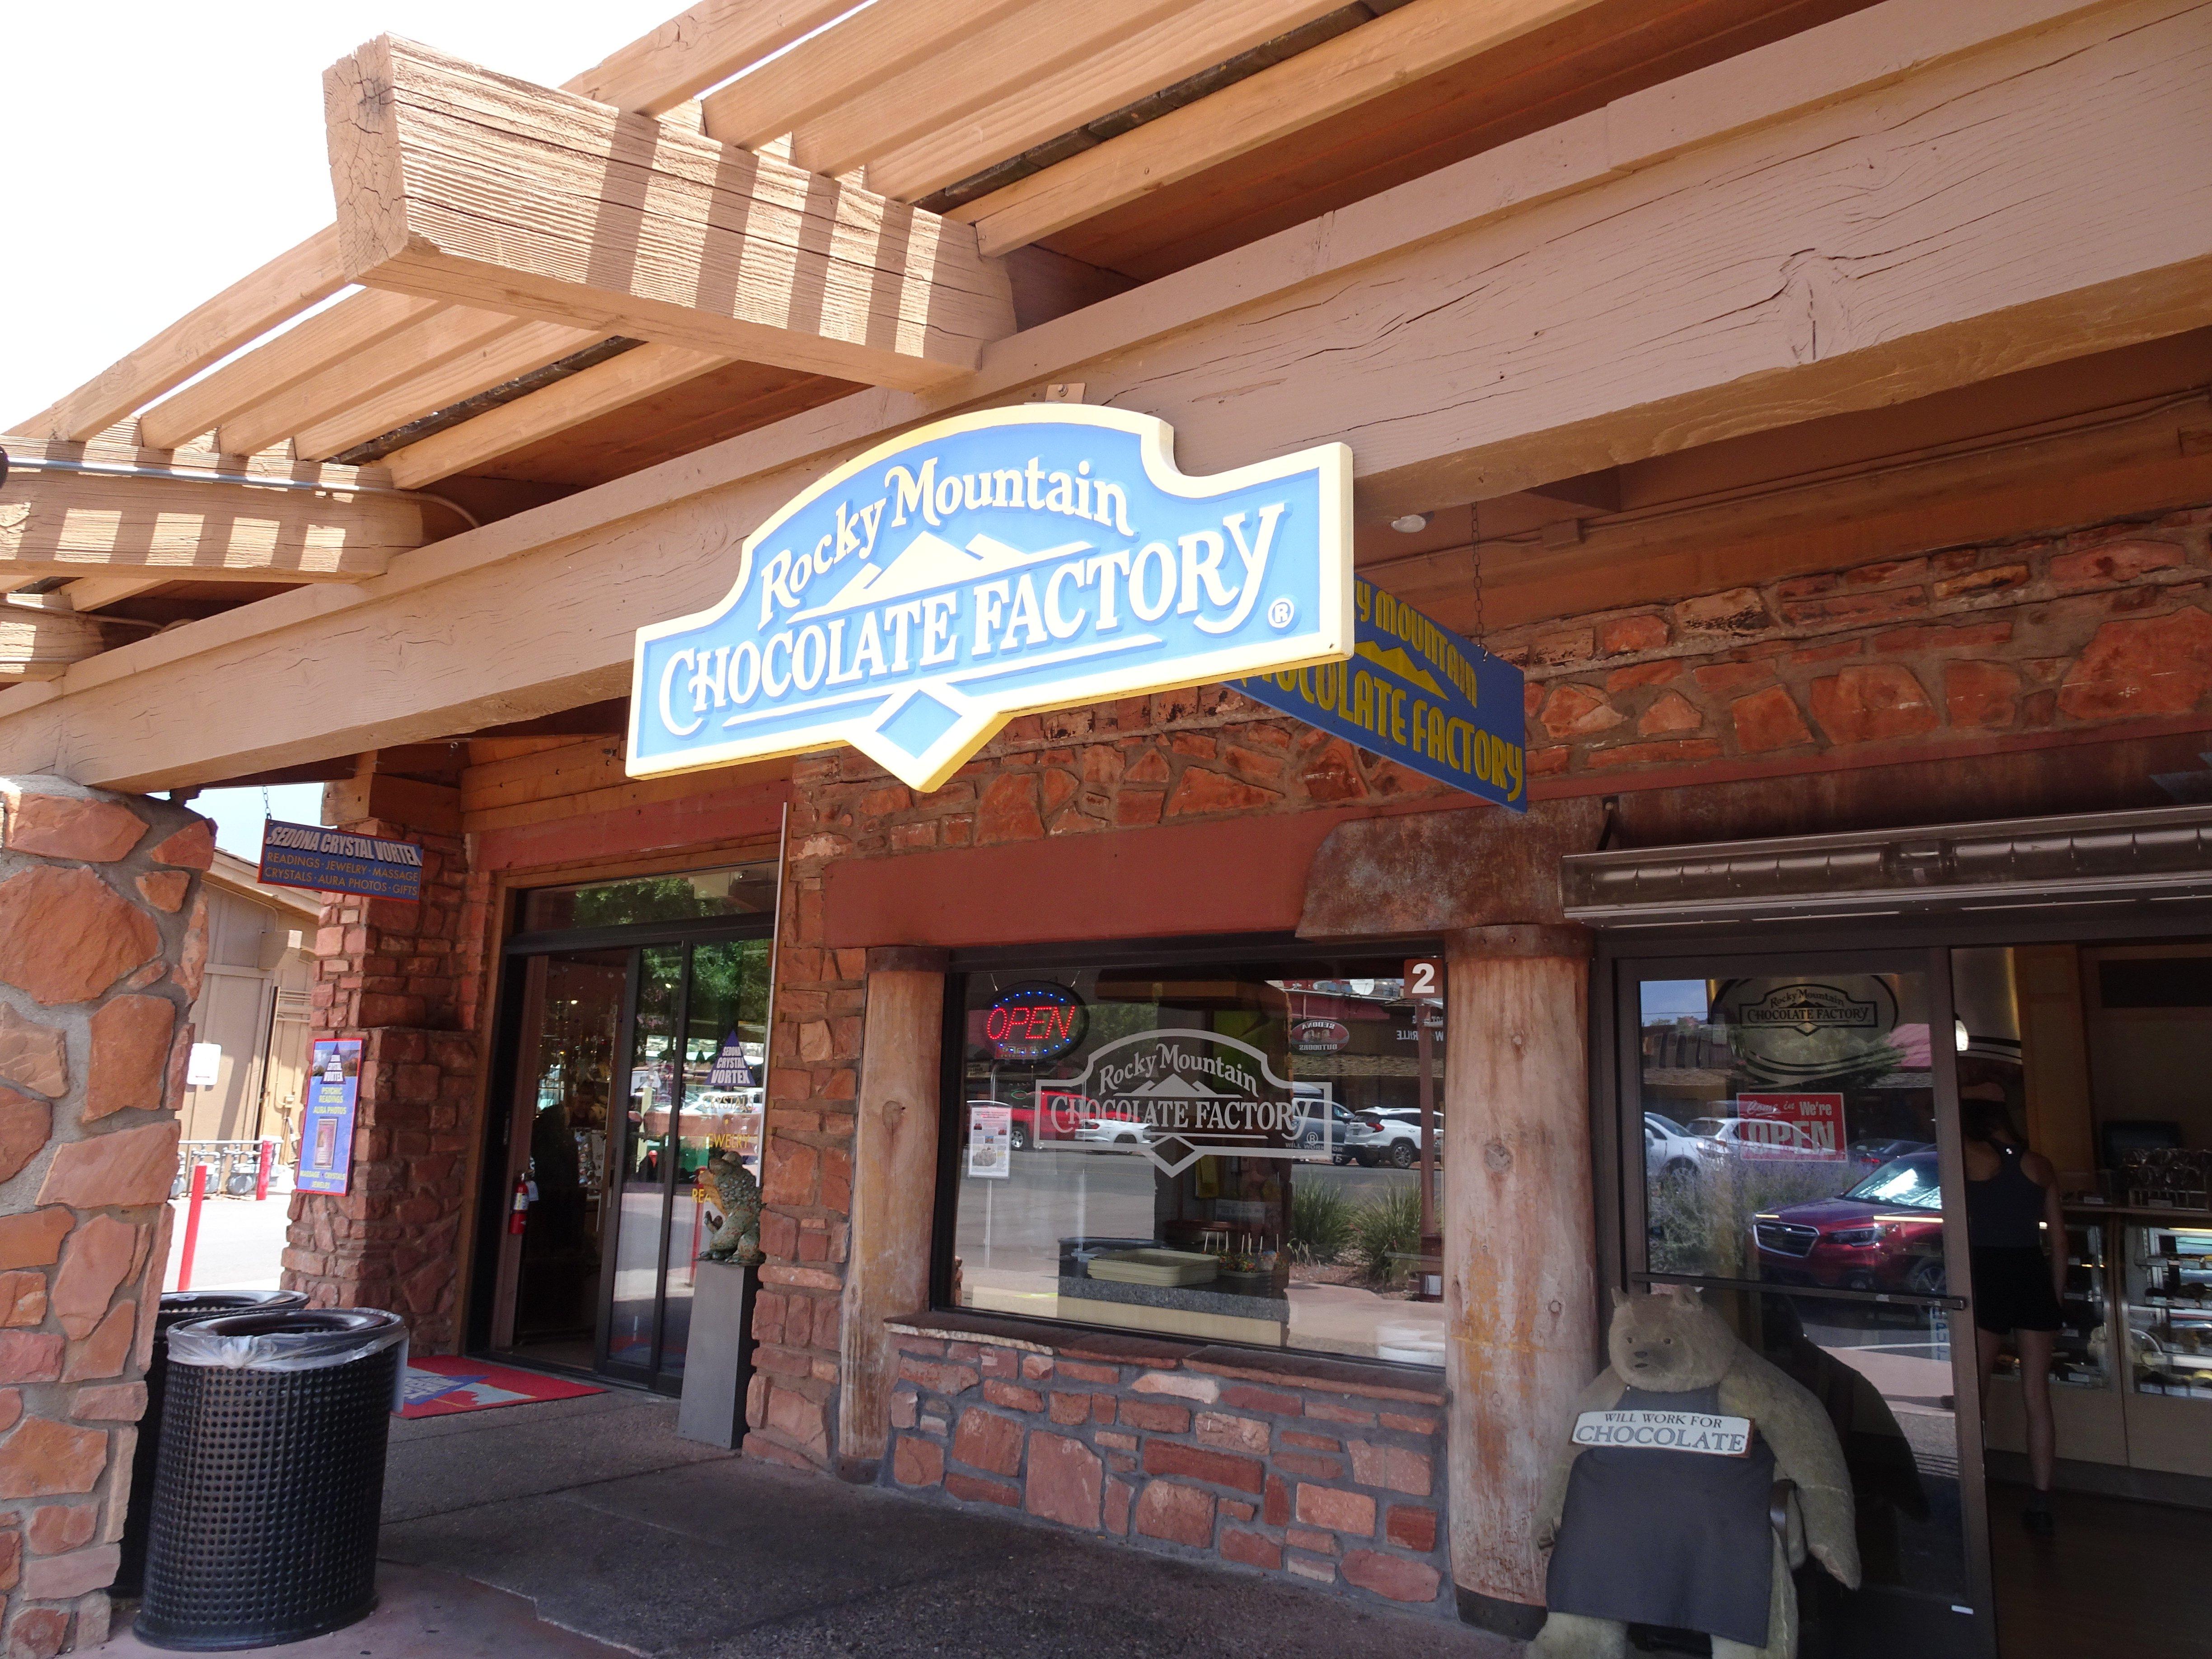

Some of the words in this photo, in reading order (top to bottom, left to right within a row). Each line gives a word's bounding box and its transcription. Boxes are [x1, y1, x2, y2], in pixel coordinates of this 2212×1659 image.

[758, 497, 886, 631] Rocky
[885, 457, 1133, 536] Mountain
[659, 589, 957, 736] CHOCOLATE
[972, 503, 1285, 655] FACTORY
[1376, 590, 1477, 708] MOUNTAIN
[1242, 661, 1406, 746] COLATE
[1413, 699, 1523, 802] FACTORY
[266, 826, 319, 850] SEDONA
[321, 833, 375, 859] CRYSTAL
[374, 841, 422, 866] VORTEX
[264, 867, 312, 883] CRYSTALS
[318, 875, 346, 887] AURA
[349, 878, 387, 892] PHOTOS
[393, 885, 418, 896] GIFTS
[267, 852, 320, 868] READINGS
[325, 861, 368, 875] JEWELRY
[373, 868, 418, 882] MASSAGE
[1412, 963, 1435, 994] 2
[1770, 992, 1797, 1008] Rocky
[1796, 989, 1845, 1007] Mountain
[987, 1005, 1076, 1039] OPEN
[1747, 1008, 1814, 1023] CHOCOLATE
[1817, 1007, 1869, 1022] FACTORY
[717, 1057, 745, 1069] CRYSTAL
[722, 1046, 741, 1056] SEDONA
[711, 1070, 750, 1084] VORTEX
[1099, 1052, 1157, 1096] Rocky
[1156, 1043, 1259, 1097] Mountain
[703, 1095, 754, 1110] CRYSTALS
[1799, 1101, 1832, 1115] We're
[1051, 1095, 1188, 1133] CHOCOLATE
[1195, 1101, 1311, 1140] FACTORY
[703, 1133, 750, 1149] JEWELRY
[1748, 1120, 1836, 1155] OPEN
[1605, 1413, 1636, 1423] WILL
[1642, 1414, 1685, 1425] WORK
[1690, 1416, 1722, 1428] FOR
[1576, 1425, 1745, 1452] CHOCOLATE
